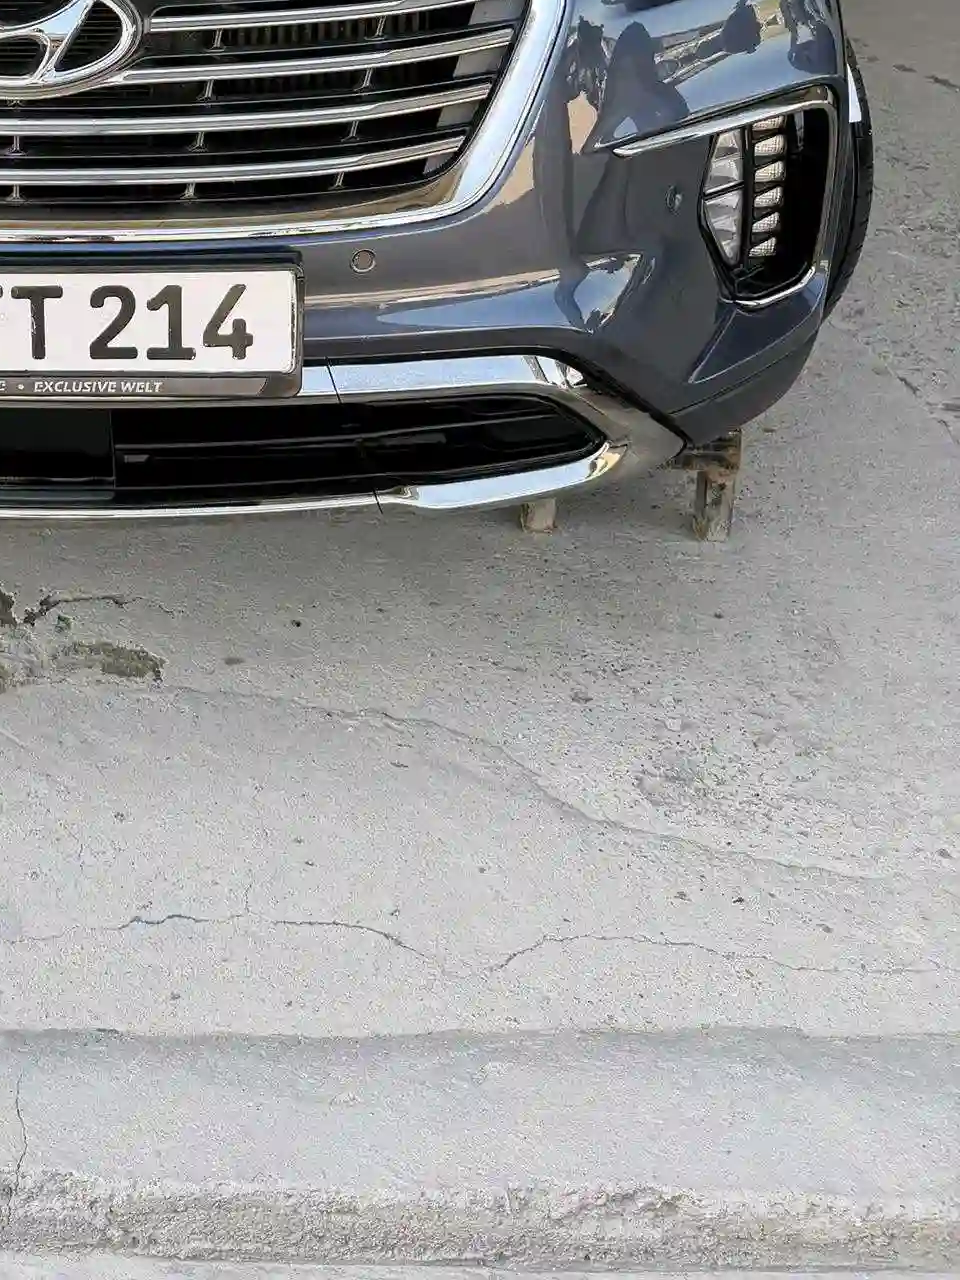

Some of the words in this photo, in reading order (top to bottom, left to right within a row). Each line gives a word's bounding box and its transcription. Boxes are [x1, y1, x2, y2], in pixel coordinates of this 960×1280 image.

[89, 284, 254, 360] 214
[34, 380, 117, 393] EXCLUSIVE
[120, 381, 163, 394] WELT
